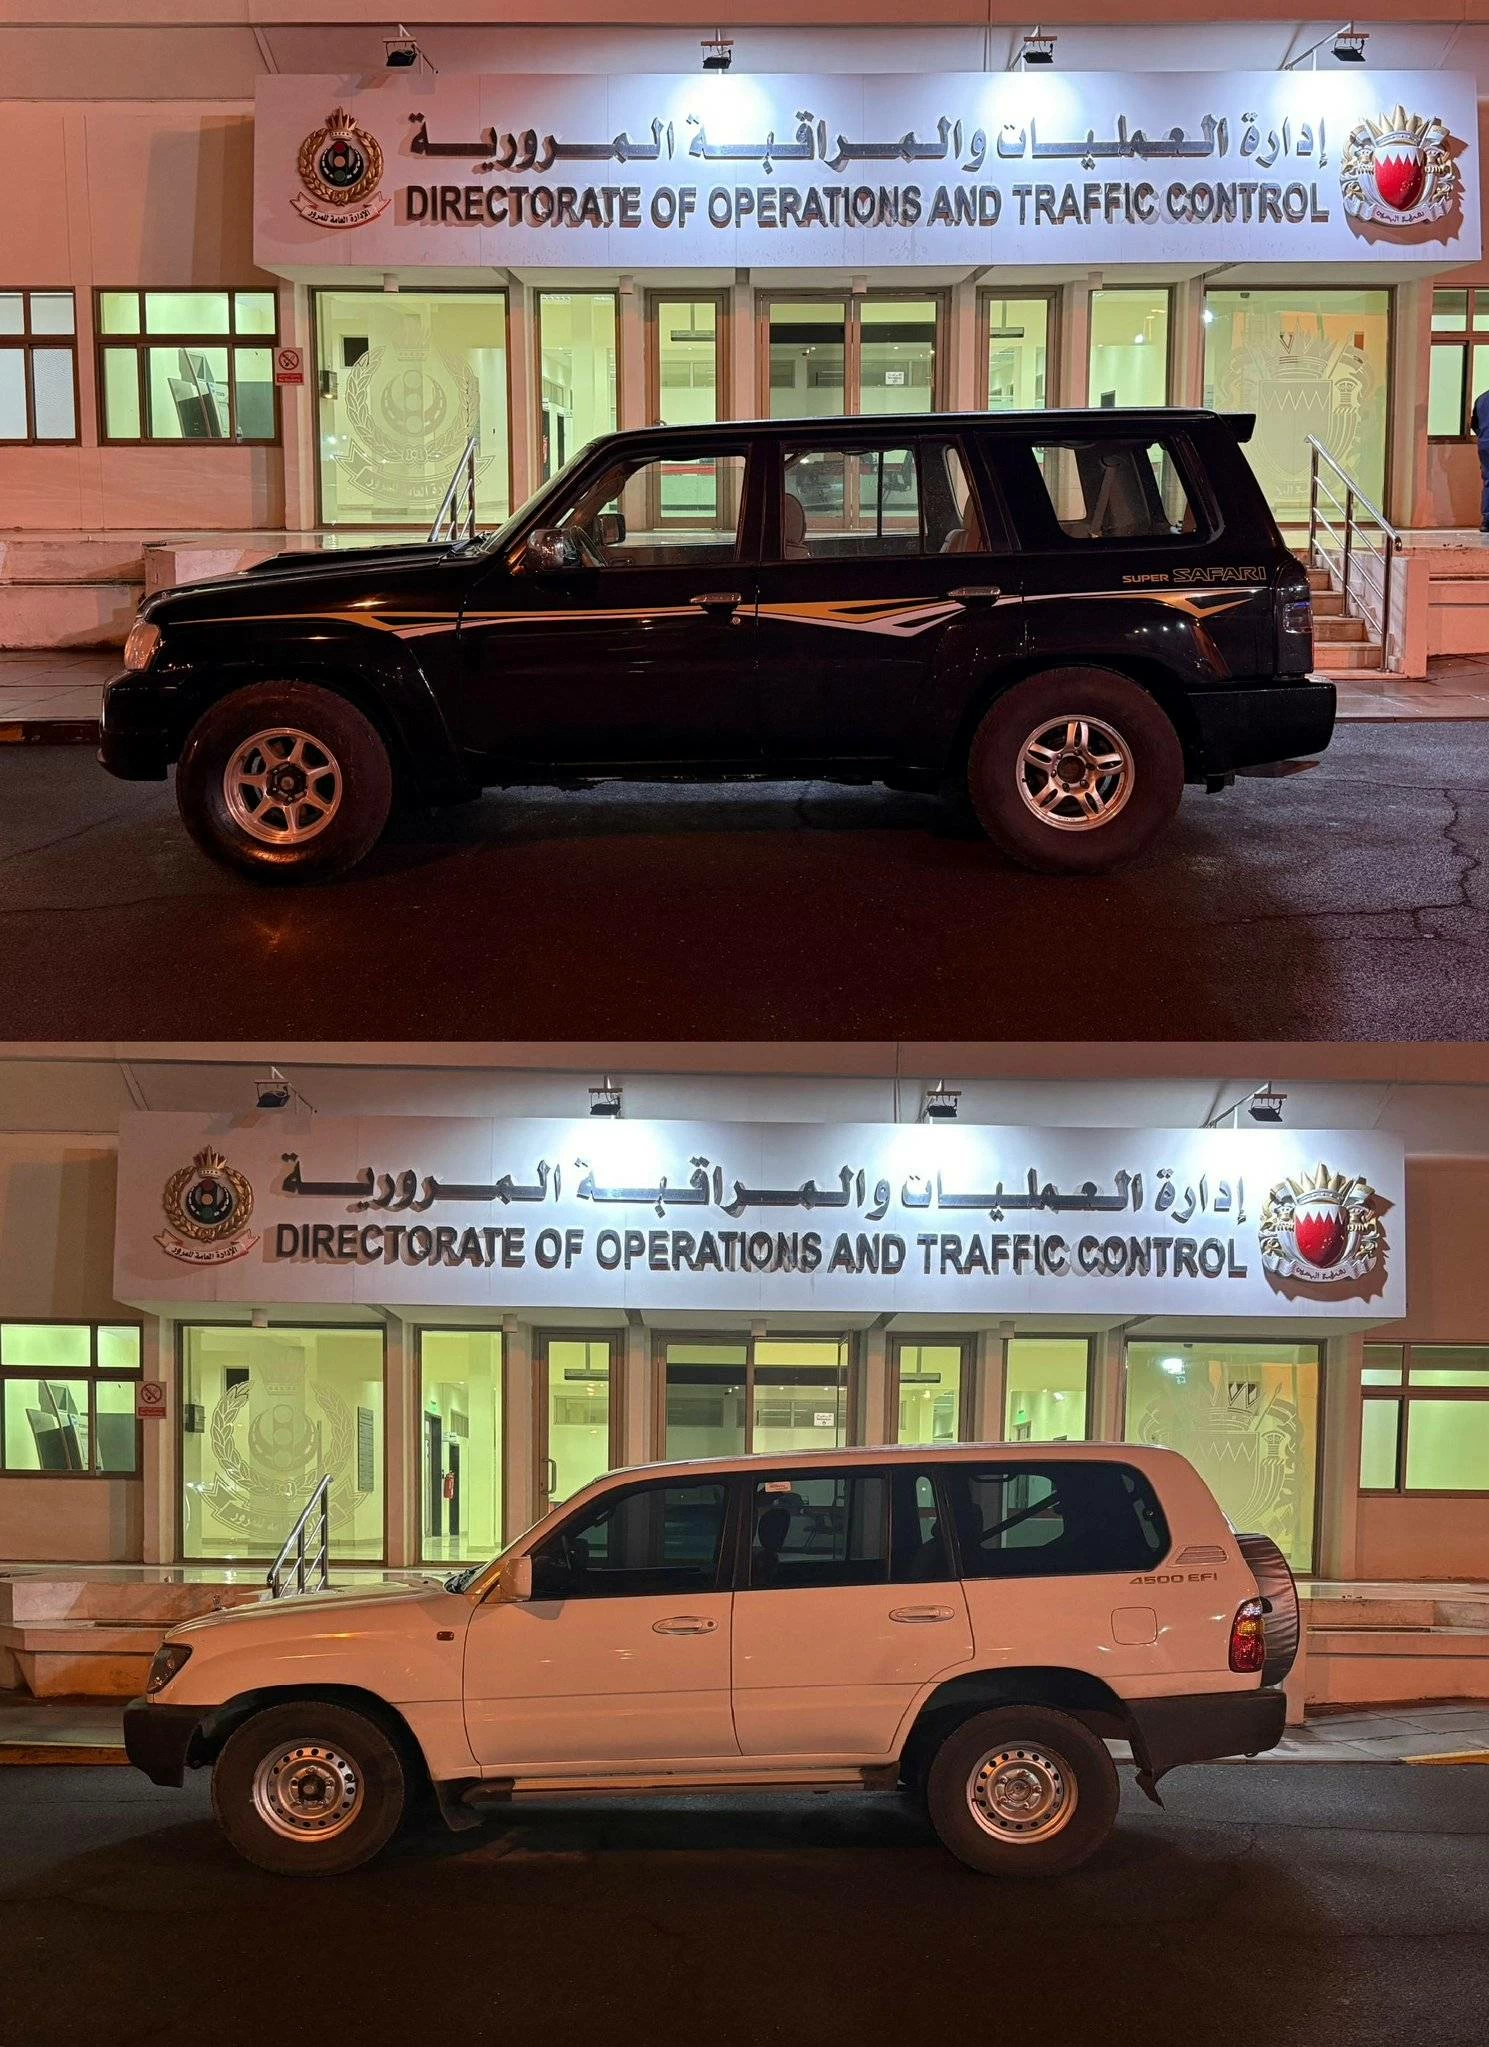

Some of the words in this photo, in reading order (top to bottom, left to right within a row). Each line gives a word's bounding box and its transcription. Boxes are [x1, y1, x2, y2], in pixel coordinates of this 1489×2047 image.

[409, 112, 674, 172] المرورية
[686, 111, 985, 174] والمراقبة
[996, 112, 1228, 170] العمليات
[1240, 111, 1327, 168] إدارة
[407, 185, 642, 228] DIRECTORATE
[651, 186, 697, 228] OF
[708, 186, 921, 228] OPERATIONS
[929, 184, 1002, 226] AND
[1012, 181, 1154, 226] TRAFFIC
[1166, 180, 1329, 224] CONTROL
[1122, 573, 1170, 584] SUPER
[1172, 566, 1267, 583] SAFARI
[282, 1152, 561, 1212] المرورية
[574, 1156, 891, 1220] والمراقبة
[901, 1165, 1143, 1222] العمليات
[1155, 1168, 1248, 1225] إدارة
[276, 1223, 525, 1269] DIRECTORATE
[536, 1228, 583, 1270] OF
[597, 1229, 823, 1274] OPERATIONS
[830, 1232, 906, 1275] AND
[917, 1233, 1066, 1276] TRAFFIC
[1078, 1236, 1248, 1278] CONTROL
[1129, 1574, 1186, 1585] 4500
[1188, 1573, 1218, 1582] EFI
